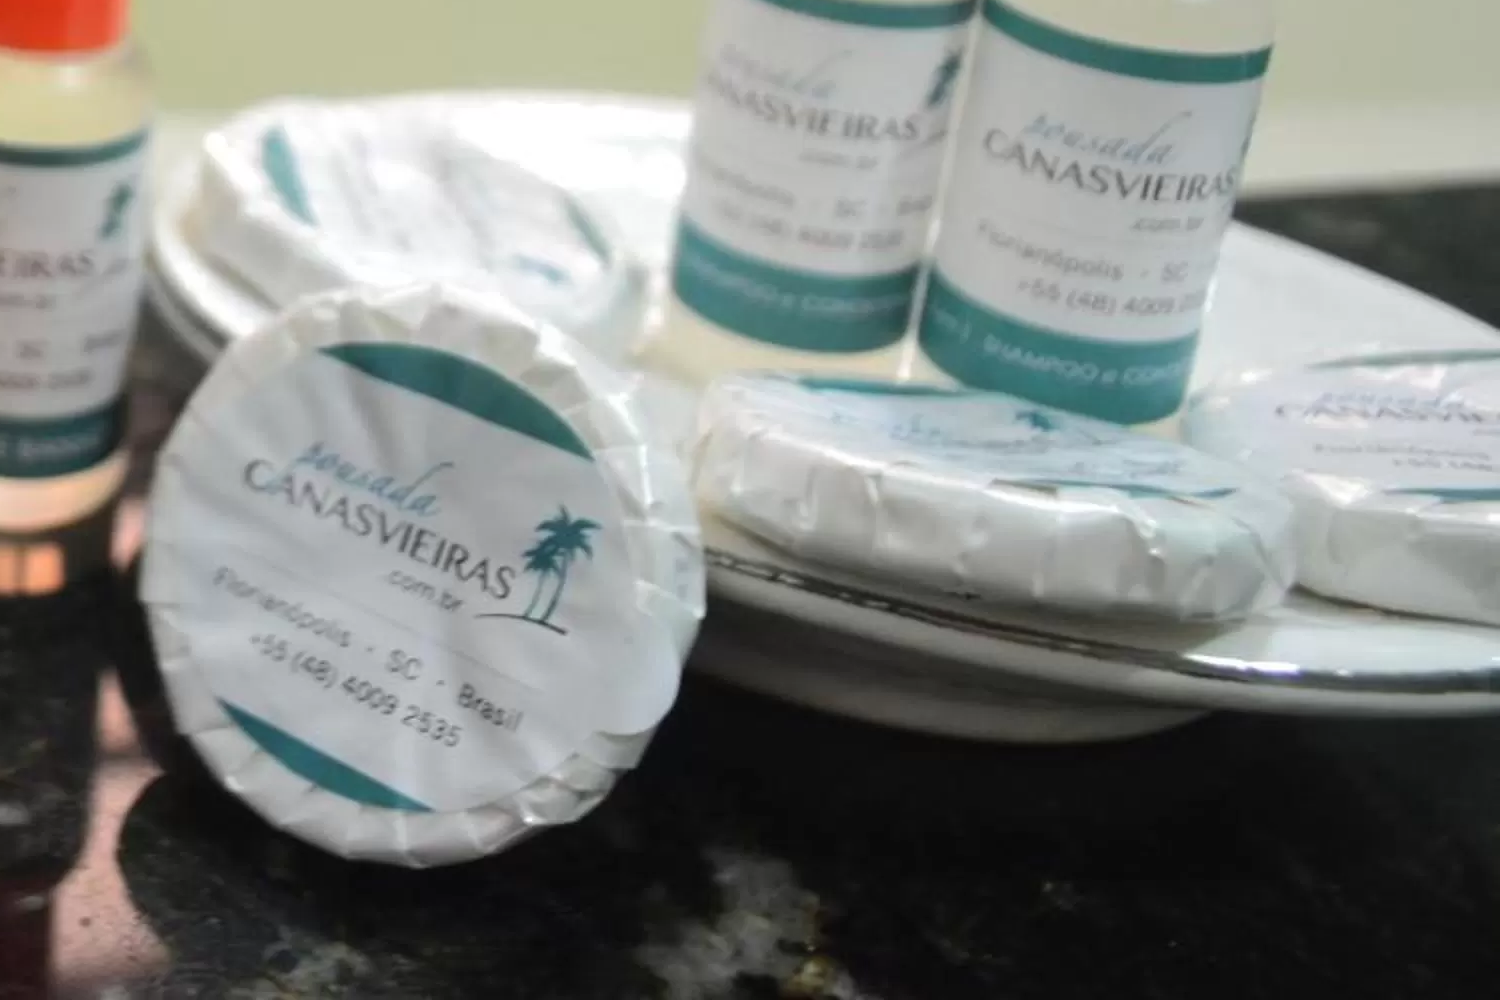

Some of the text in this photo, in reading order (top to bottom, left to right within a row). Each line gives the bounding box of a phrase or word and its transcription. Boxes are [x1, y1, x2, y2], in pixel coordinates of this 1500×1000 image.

[981, 126, 1238, 203] CANASVIEIRAS
[240, 457, 518, 601] CANASVIEIRAS
[249, 633, 465, 749] +55 (48) 4009 2535
[385, 648, 424, 681] SC
[456, 681, 526, 733] Brasil
